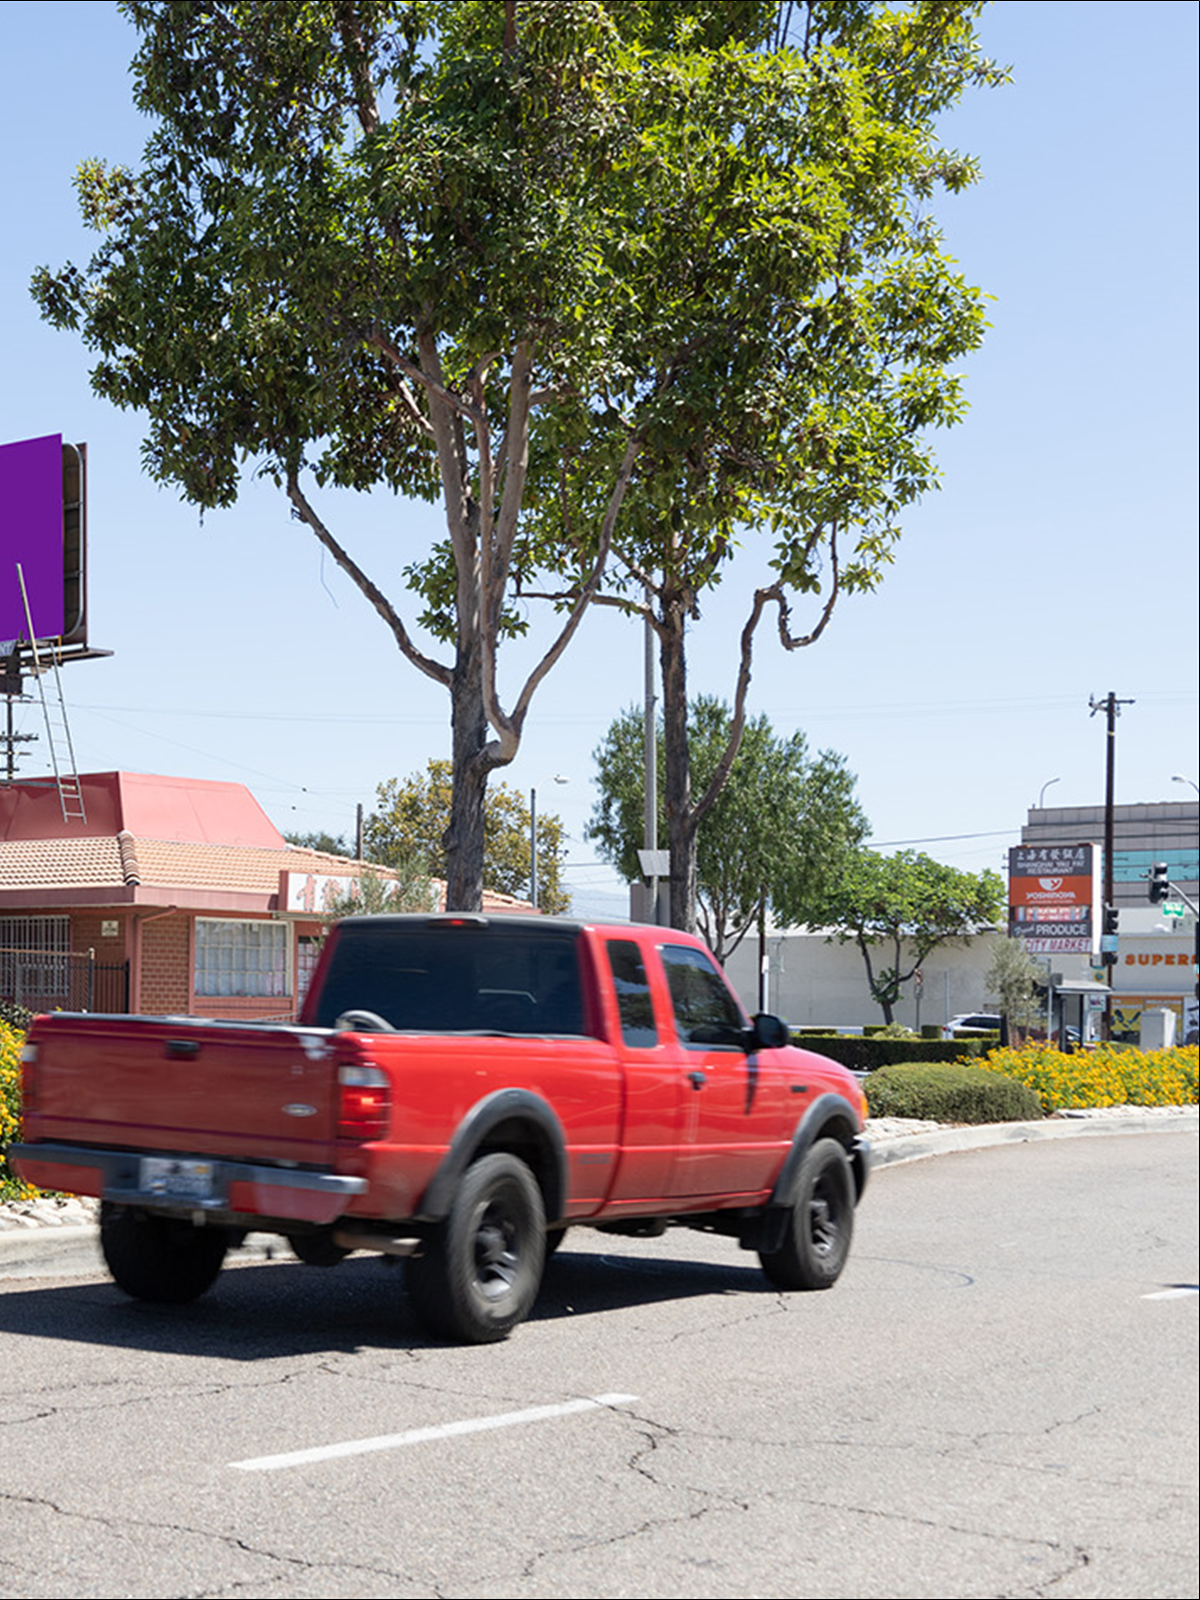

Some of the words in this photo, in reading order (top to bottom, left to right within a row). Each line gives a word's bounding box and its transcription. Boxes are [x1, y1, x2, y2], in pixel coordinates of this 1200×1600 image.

[1026, 867, 1074, 875] RESTAURANT
[1025, 892, 1076, 900] YOSHINOYA
[1035, 924, 1088, 936] PRODUCE
[1026, 938, 1046, 951] CITY
[1049, 938, 1090, 951] MARKET
